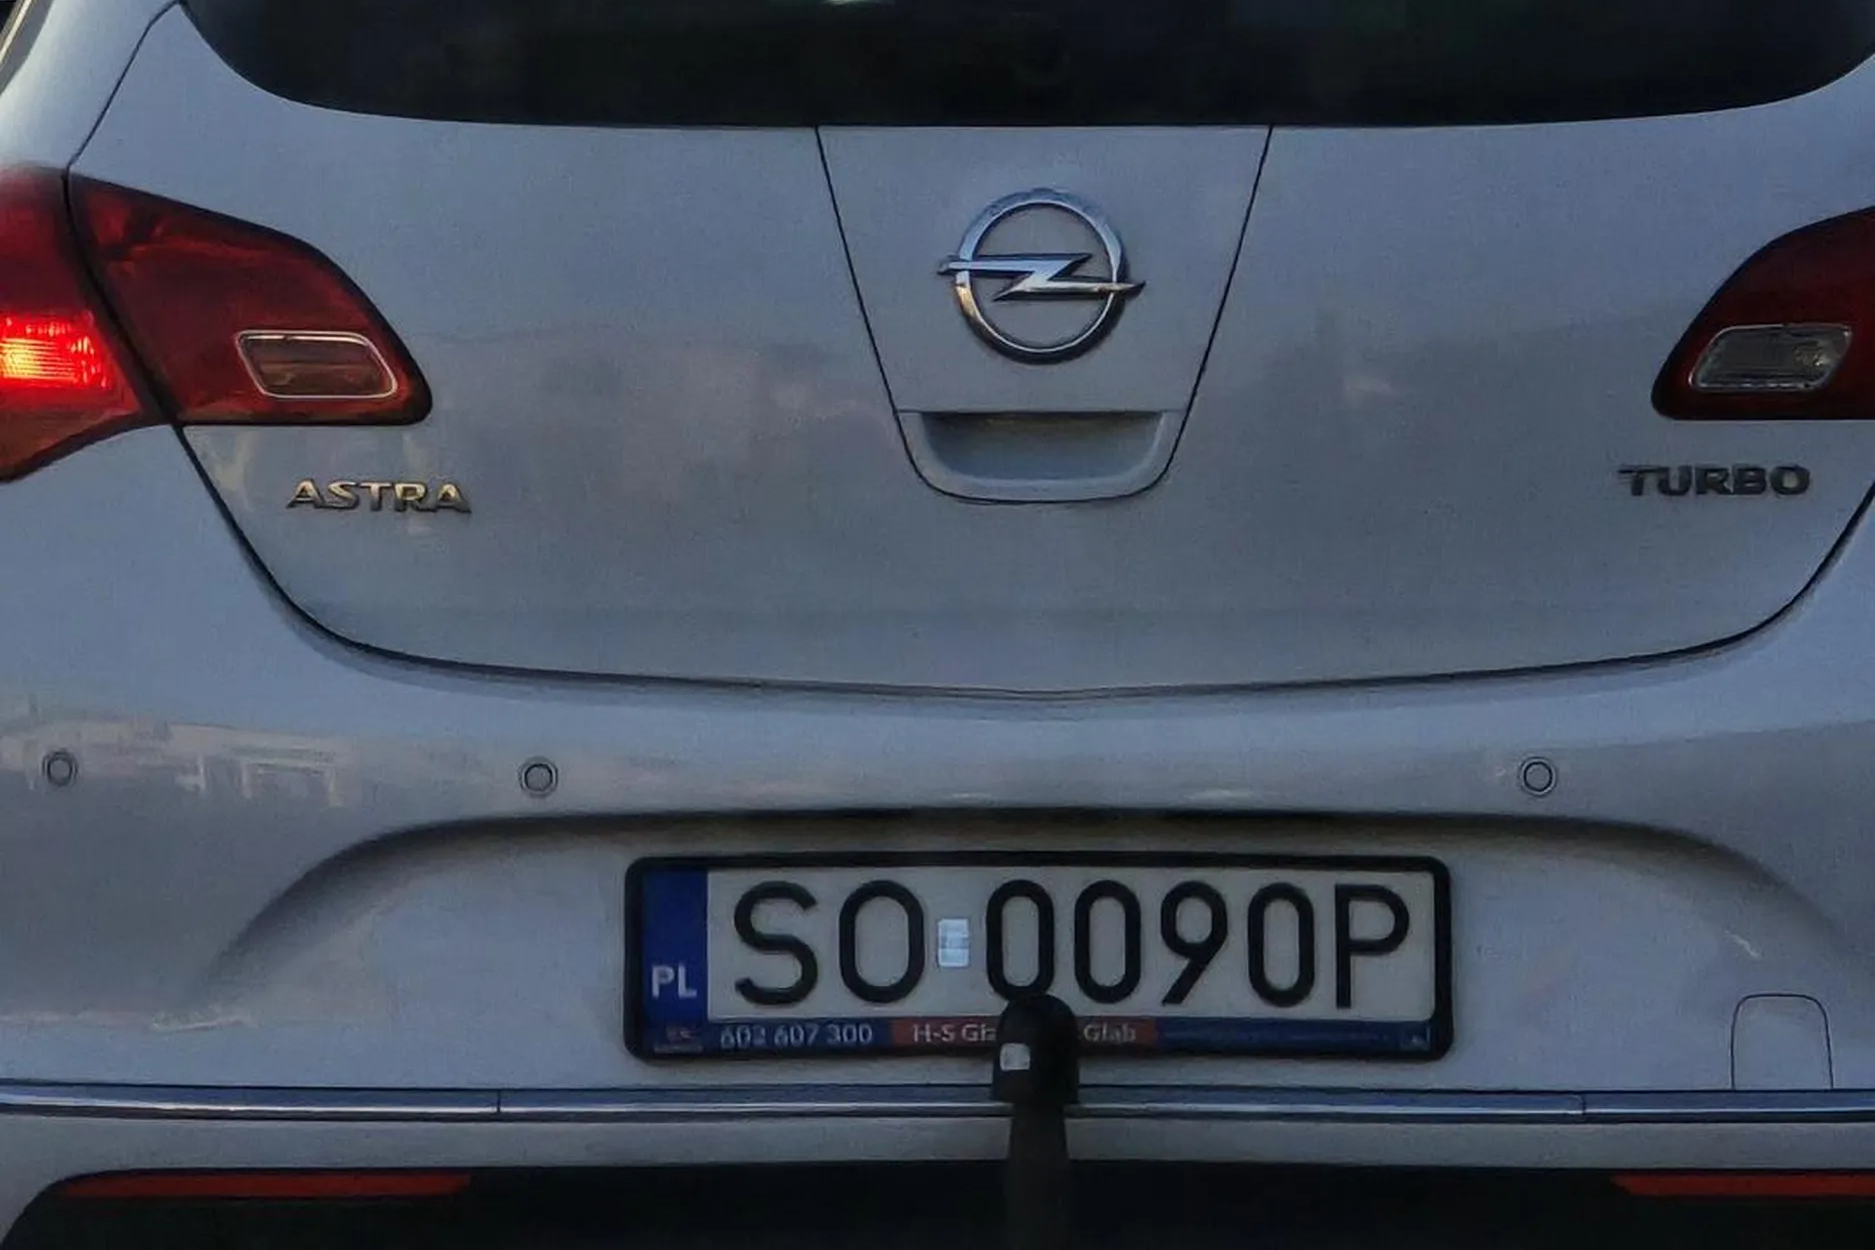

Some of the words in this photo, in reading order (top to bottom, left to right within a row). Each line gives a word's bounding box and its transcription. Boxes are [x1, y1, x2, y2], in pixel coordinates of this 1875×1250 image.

[286, 478, 472, 513] ASTRA
[1617, 464, 1811, 497] TURBO
[733, 879, 925, 1005] SO
[985, 880, 1411, 1010] 0090P
[652, 963, 697, 998] PL
[773, 1024, 819, 1047] 607
[825, 1023, 873, 1043] 300
